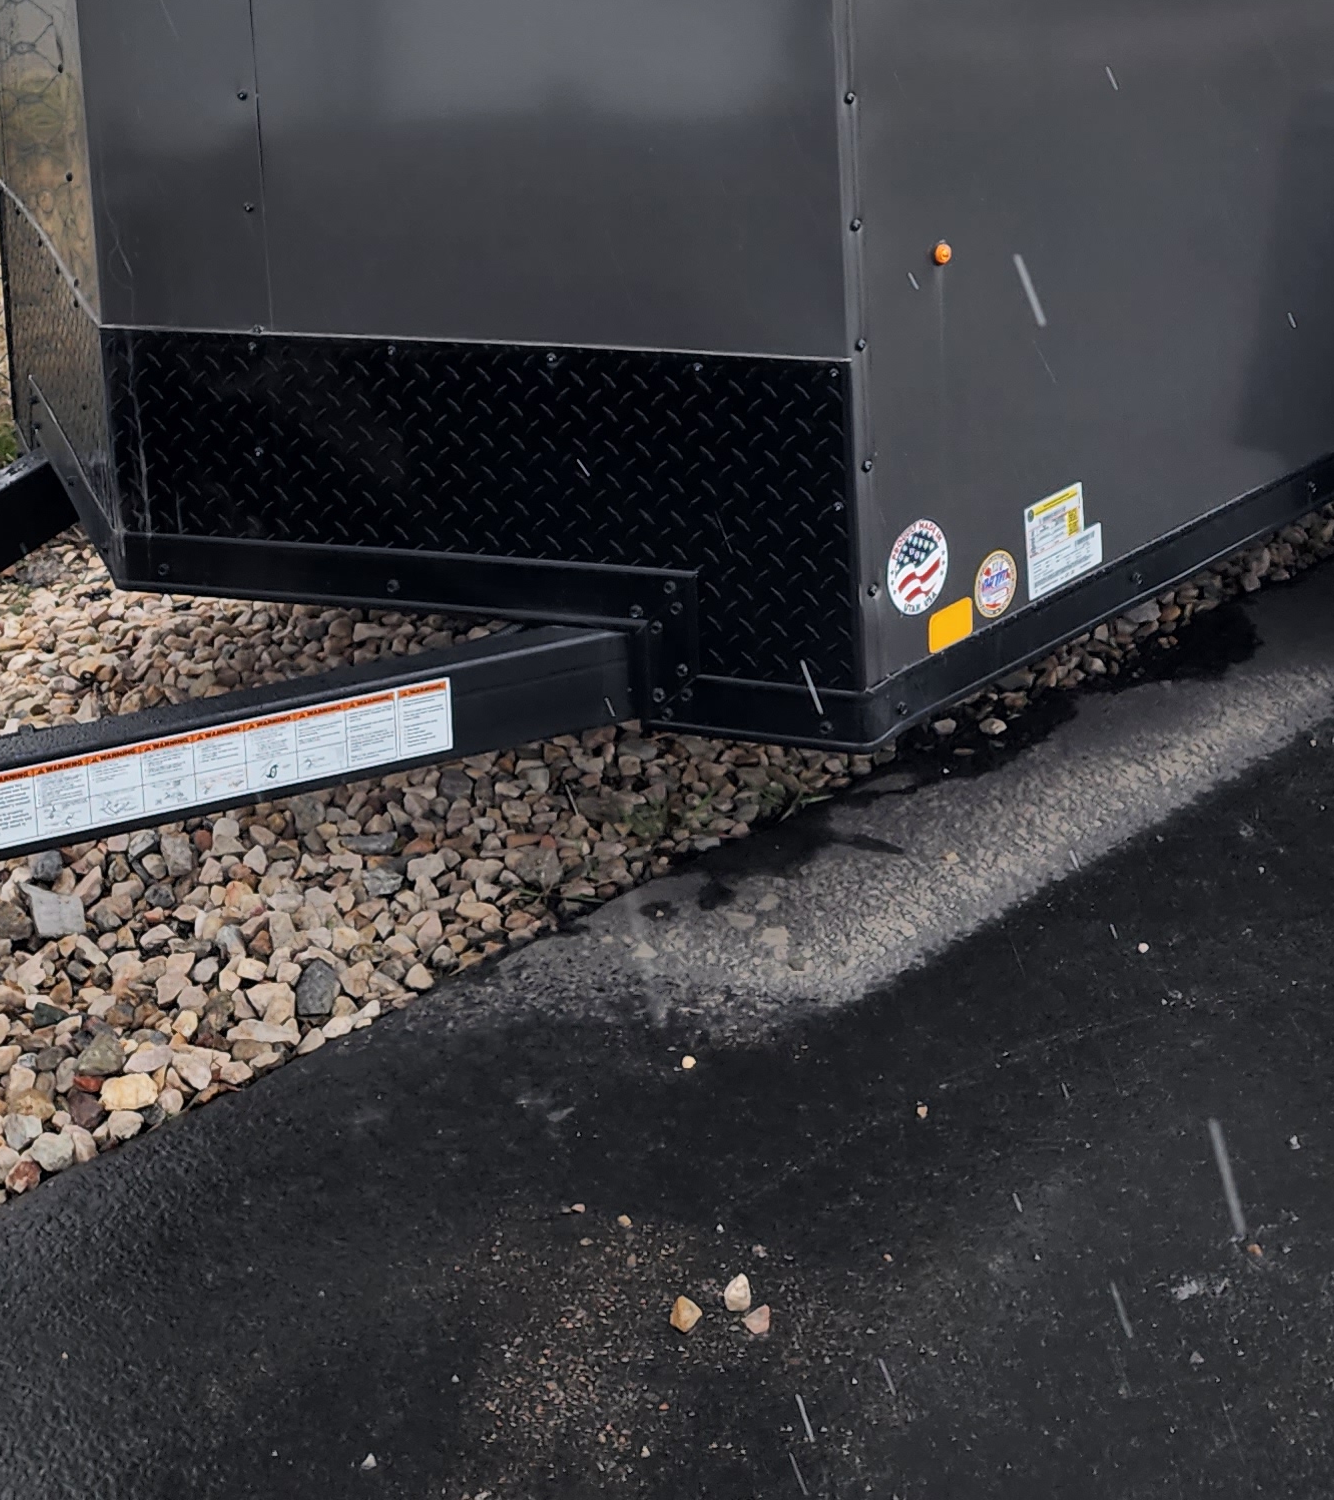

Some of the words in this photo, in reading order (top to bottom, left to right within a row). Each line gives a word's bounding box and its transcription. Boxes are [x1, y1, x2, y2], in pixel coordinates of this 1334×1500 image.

[308, 705, 341, 717] WARNING
[257, 715, 291, 727] WARNING
[207, 727, 240, 738] WARNING
[153, 737, 187, 749] WARNING
[100, 748, 135, 761] WARNING
[47, 760, 82, 773] WARNING
